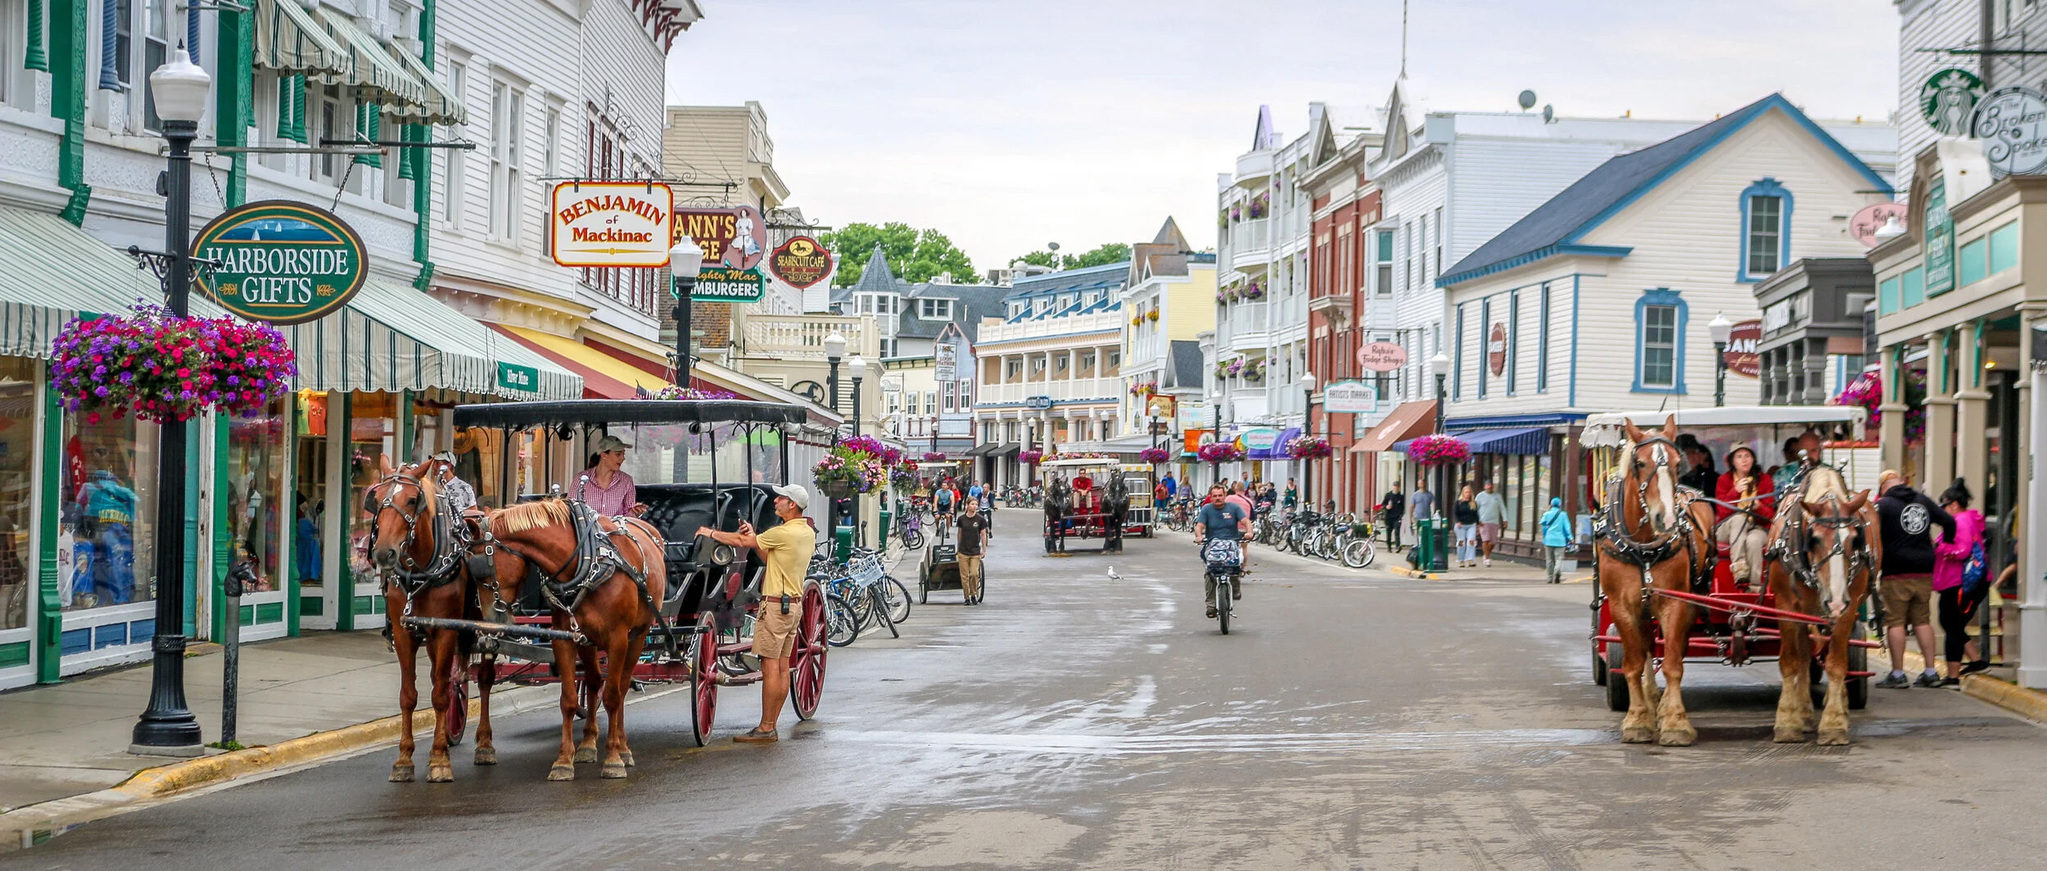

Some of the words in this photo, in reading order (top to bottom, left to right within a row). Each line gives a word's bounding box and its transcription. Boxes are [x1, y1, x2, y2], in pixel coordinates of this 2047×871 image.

[2001, 98, 2019, 110] The
[1979, 102, 2046, 138] Broken
[558, 195, 667, 227] BENJAMIN
[605, 215, 619, 224] of
[571, 227, 653, 243] Mackinac
[206, 247, 350, 275] HARBORSIDE
[726, 270, 758, 281] Mac
[241, 276, 312, 304] GIFTS
[1328, 390, 1349, 399] ARTISTS
[1350, 390, 1372, 399] MARKET
